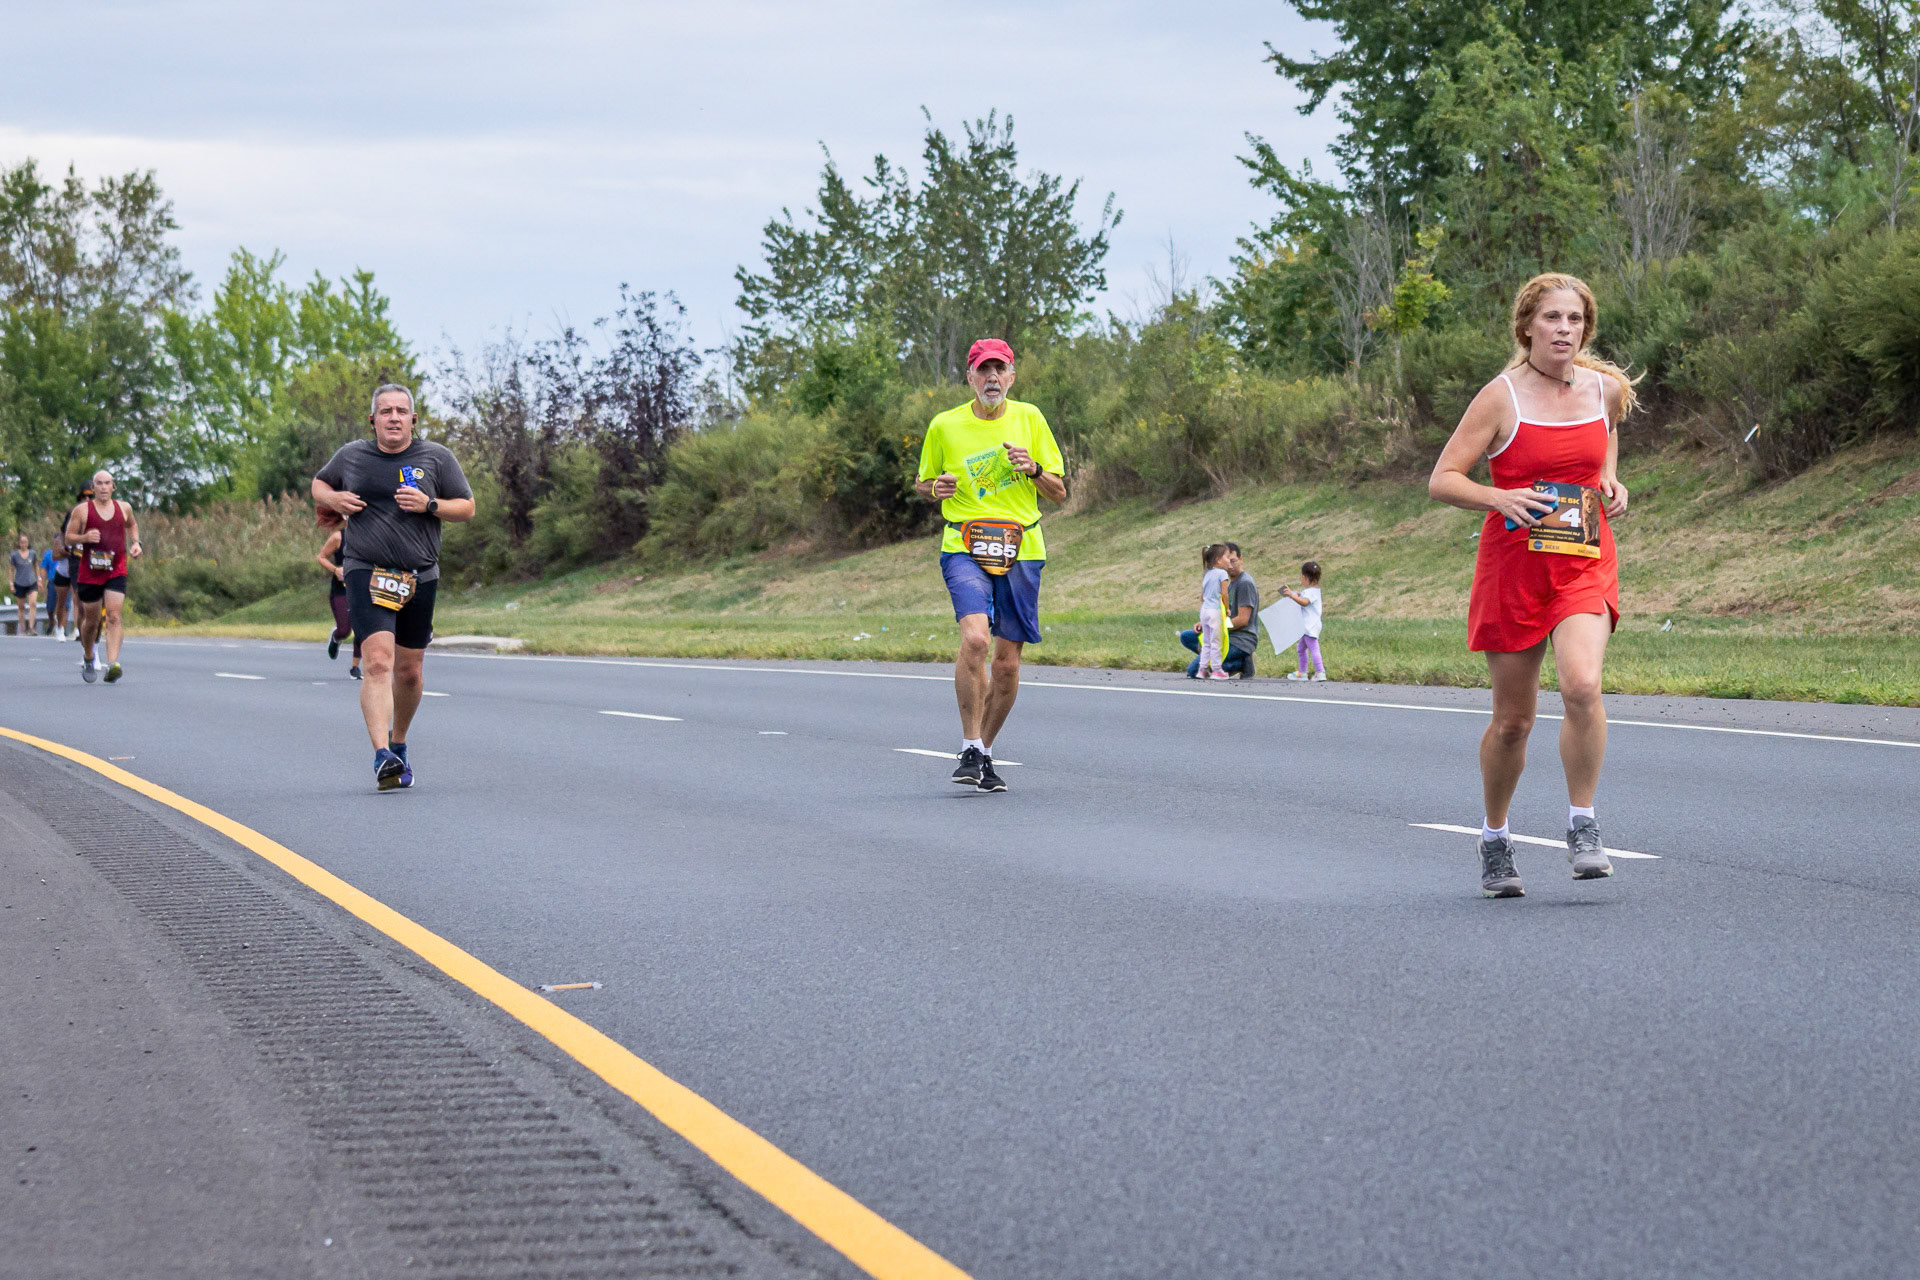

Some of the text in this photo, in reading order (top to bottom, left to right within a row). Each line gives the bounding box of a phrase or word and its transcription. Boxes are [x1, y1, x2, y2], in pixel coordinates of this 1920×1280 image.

[1560, 508, 1581, 527] 4
[972, 541, 1016, 558] 265
[377, 576, 410, 597] 105
